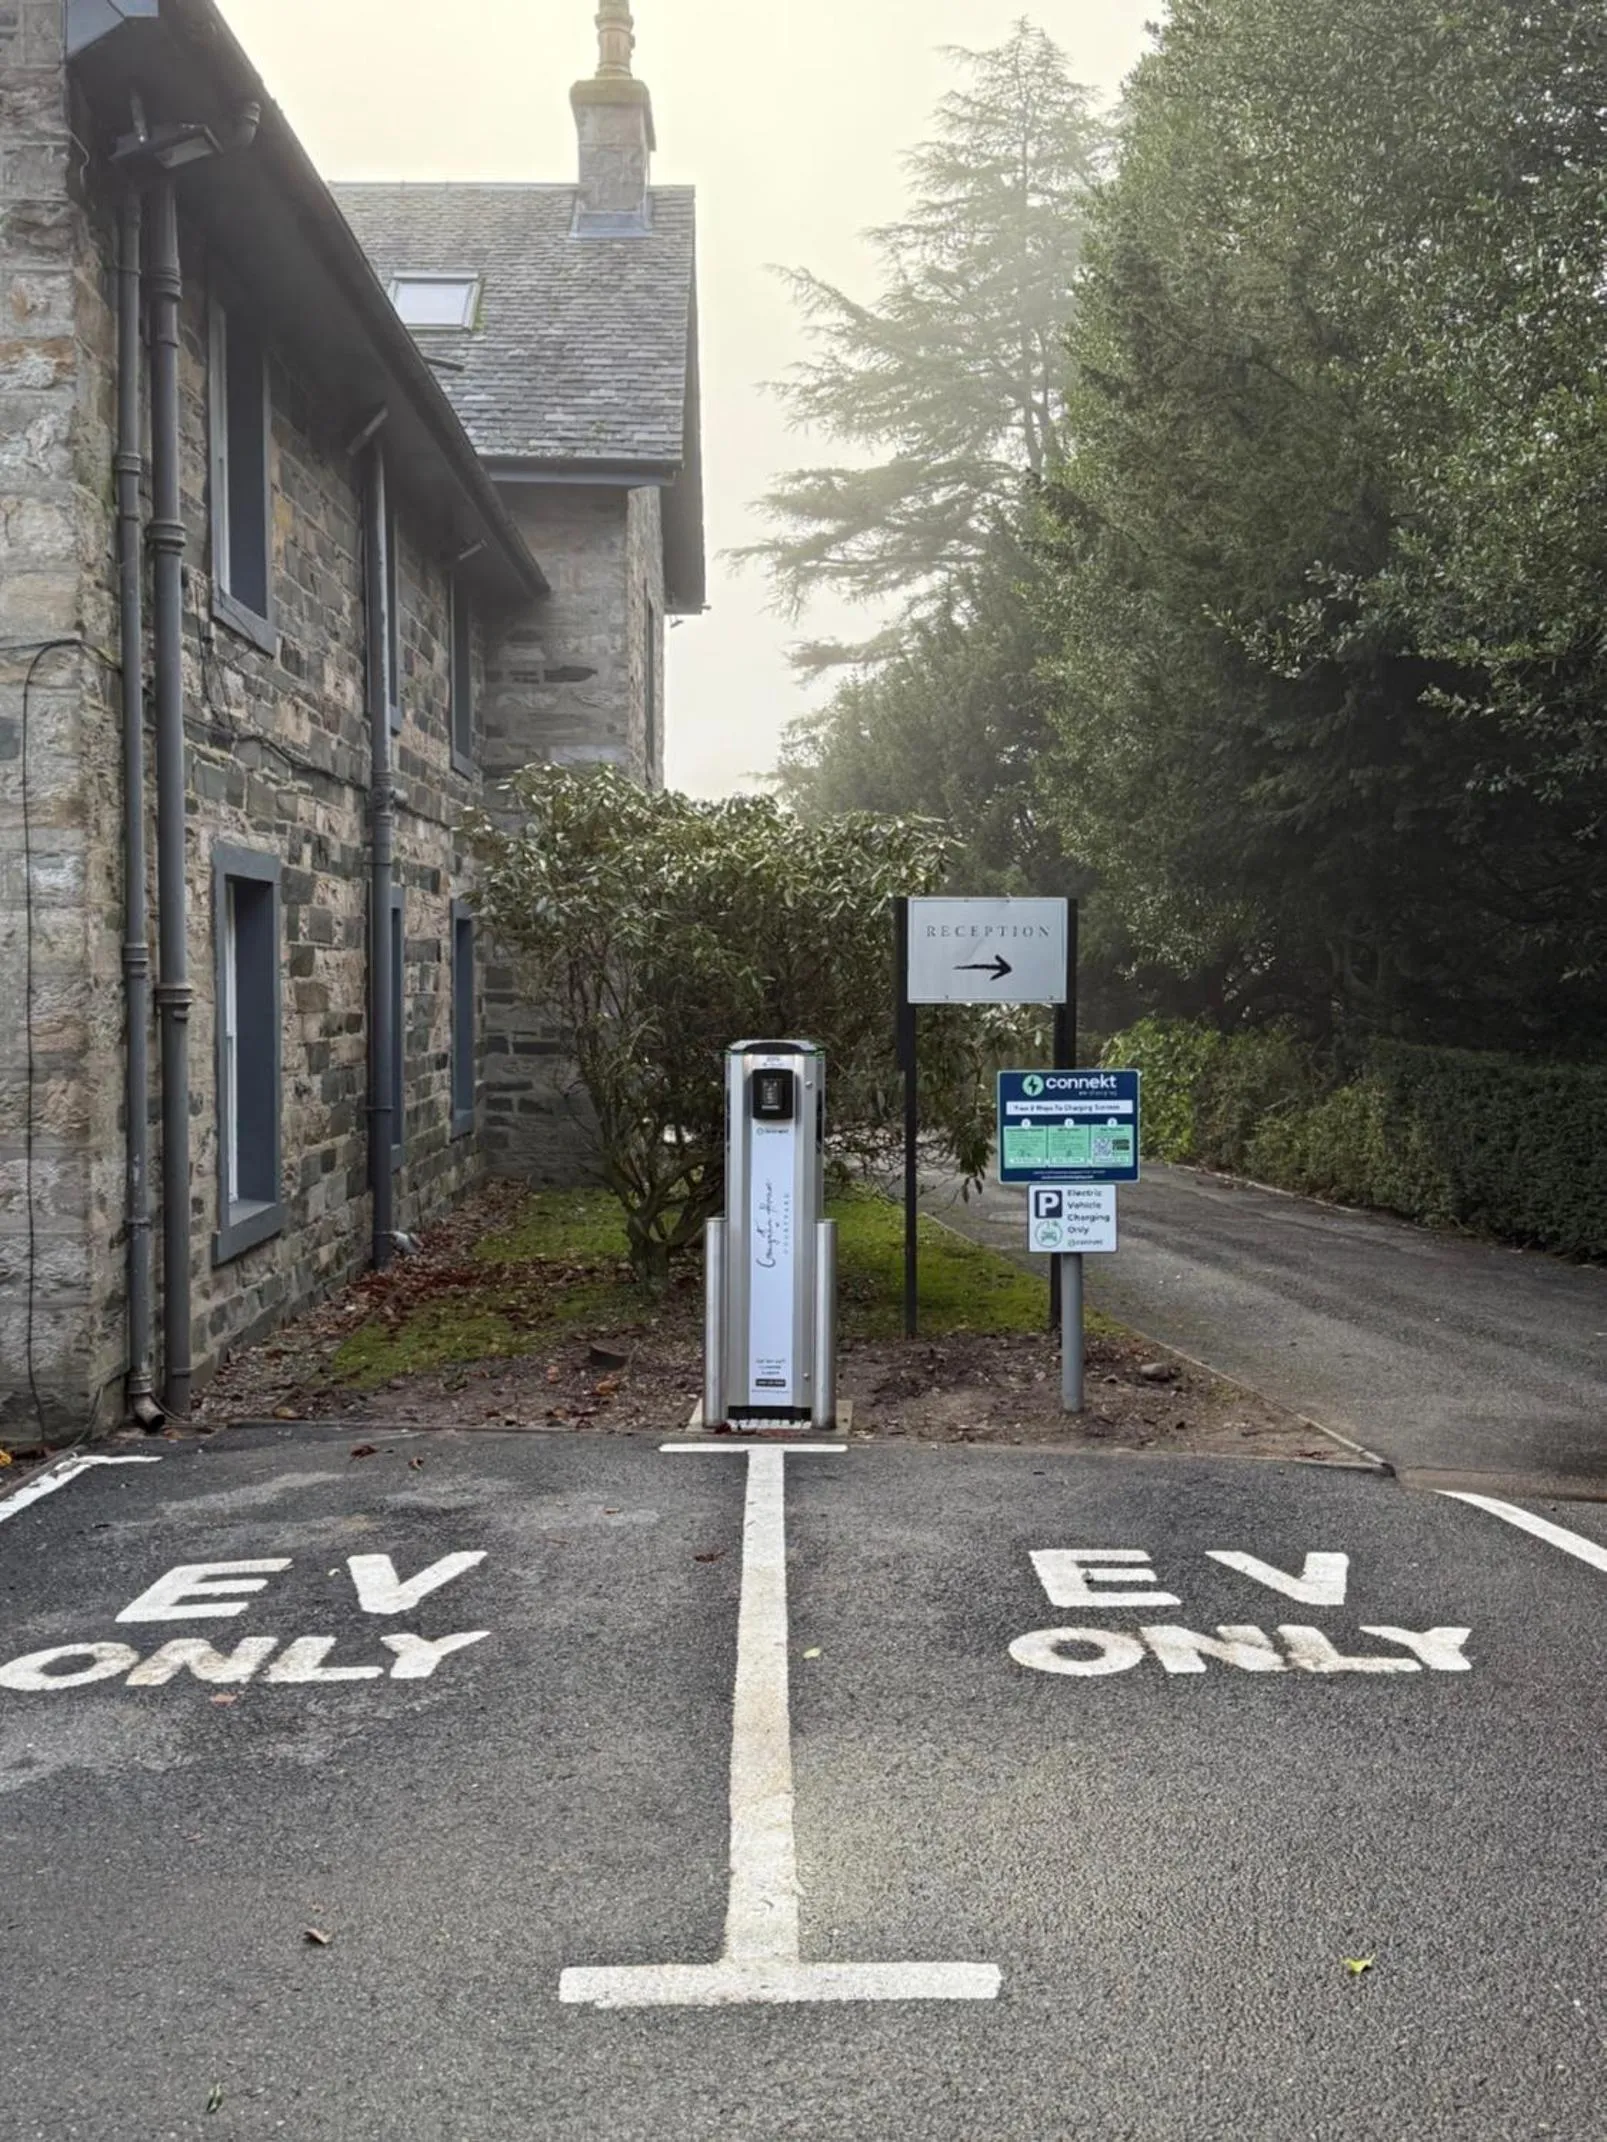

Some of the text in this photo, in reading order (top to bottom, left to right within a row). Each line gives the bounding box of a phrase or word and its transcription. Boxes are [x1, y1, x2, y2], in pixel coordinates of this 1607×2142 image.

[926, 925, 1050, 937] RECEPTION
[1046, 1074, 1117, 1089] connekt
[1067, 1189, 1102, 1197] Electric
[1038, 1193, 1060, 1216] P
[1067, 1201, 1102, 1209] Vehicle
[1067, 1213, 1110, 1223] Charging
[1067, 1226, 1089, 1235] Only
[1008, 1625, 1473, 1676] ONLY
[0, 1631, 490, 1691] ONLY
